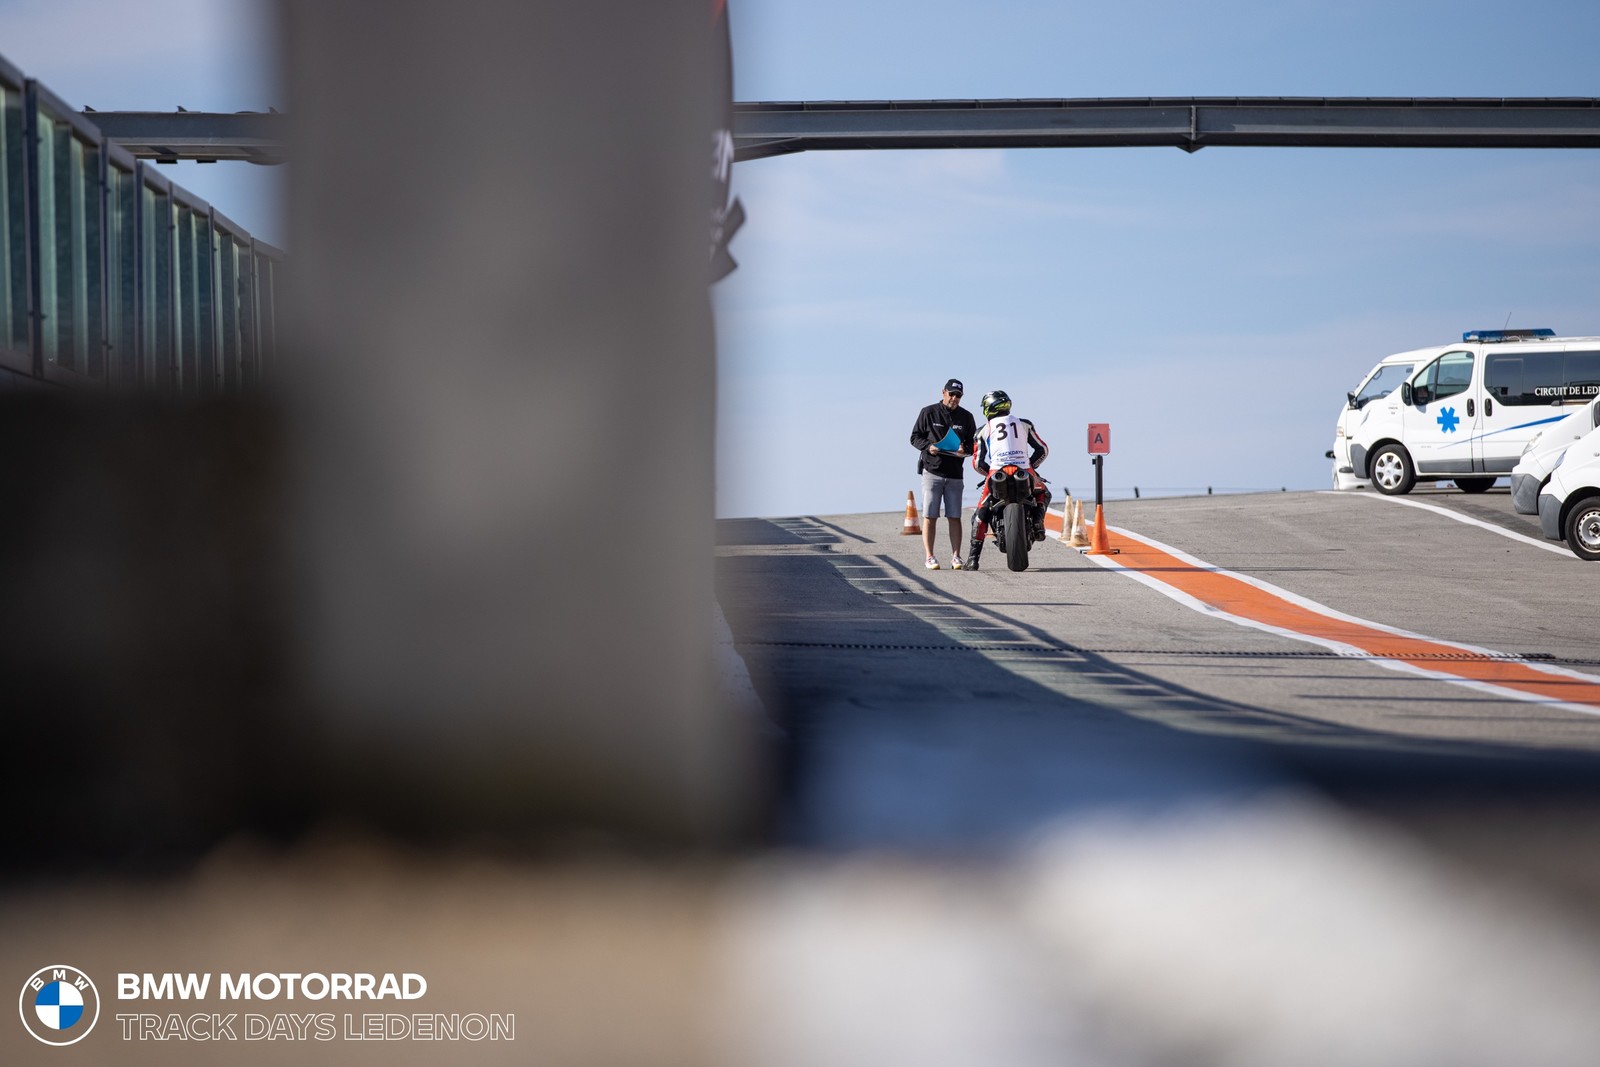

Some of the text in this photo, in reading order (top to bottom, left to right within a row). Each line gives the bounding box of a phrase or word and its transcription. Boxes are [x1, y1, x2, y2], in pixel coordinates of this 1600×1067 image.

[1534, 386, 1568, 396] CIRCUIT
[1569, 386, 1580, 395] DE
[996, 421, 1018, 441] 31
[1094, 433, 1103, 444] A
